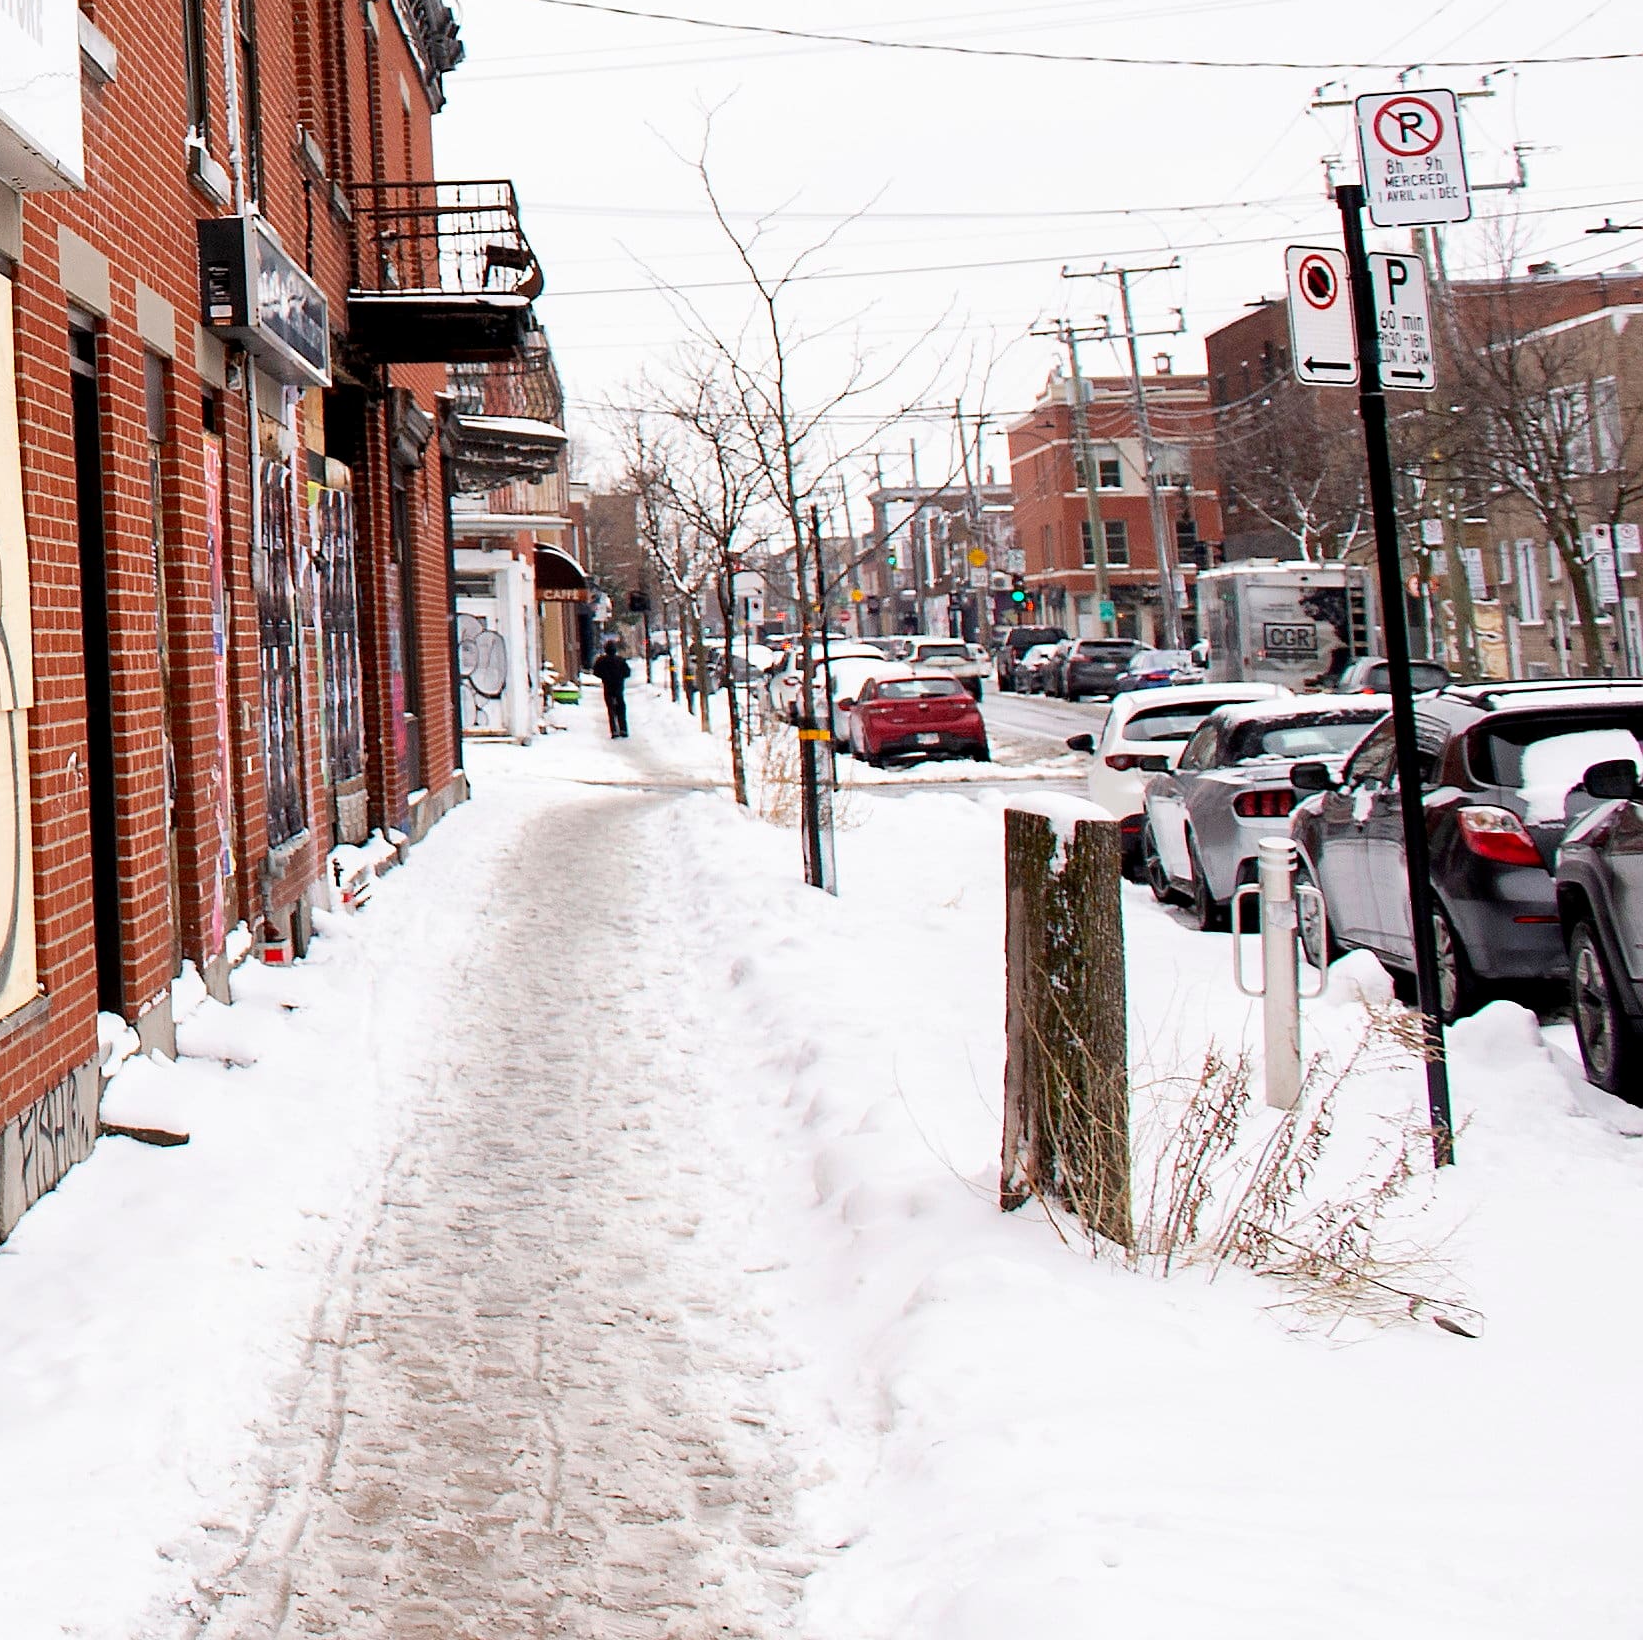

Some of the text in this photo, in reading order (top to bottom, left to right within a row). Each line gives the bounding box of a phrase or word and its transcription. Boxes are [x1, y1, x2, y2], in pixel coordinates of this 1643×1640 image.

[1386, 159, 1404, 175] 8h
[1425, 156, 1444, 171] 9h
[1384, 173, 1449, 188] MERCREDI
[1387, 189, 1416, 203] AVRIL
[1438, 186, 1459, 200] DEC
[1386, 258, 1408, 305] P
[1380, 309, 1424, 331] 60 min
[1271, 628, 1310, 647] CGR
